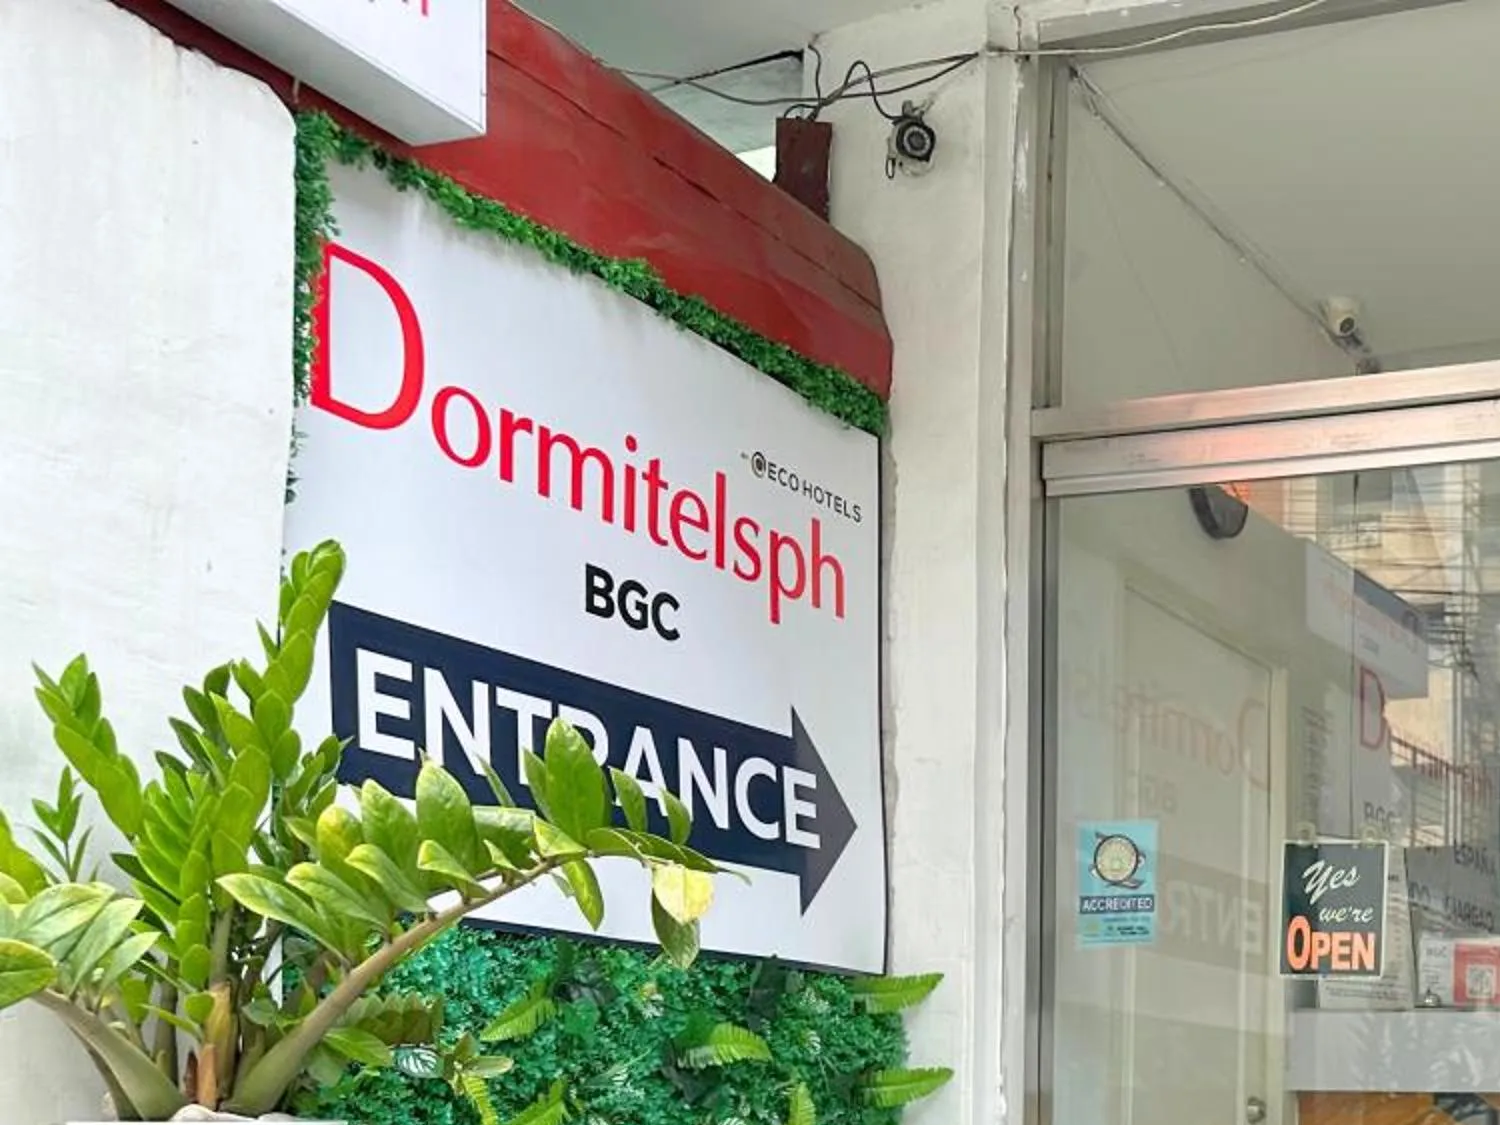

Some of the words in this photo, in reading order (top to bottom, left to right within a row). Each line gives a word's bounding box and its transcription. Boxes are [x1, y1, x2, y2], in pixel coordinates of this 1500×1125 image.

[310, 242, 845, 624] Dormitelsph
[802, 479, 862, 523] HOTELS
[584, 562, 681, 642] BGC
[1082, 896, 1153, 912] ACCREDITED
[1302, 859, 1361, 905] Yes
[1318, 906, 1374, 924] we're
[1287, 914, 1376, 971] OPEN
